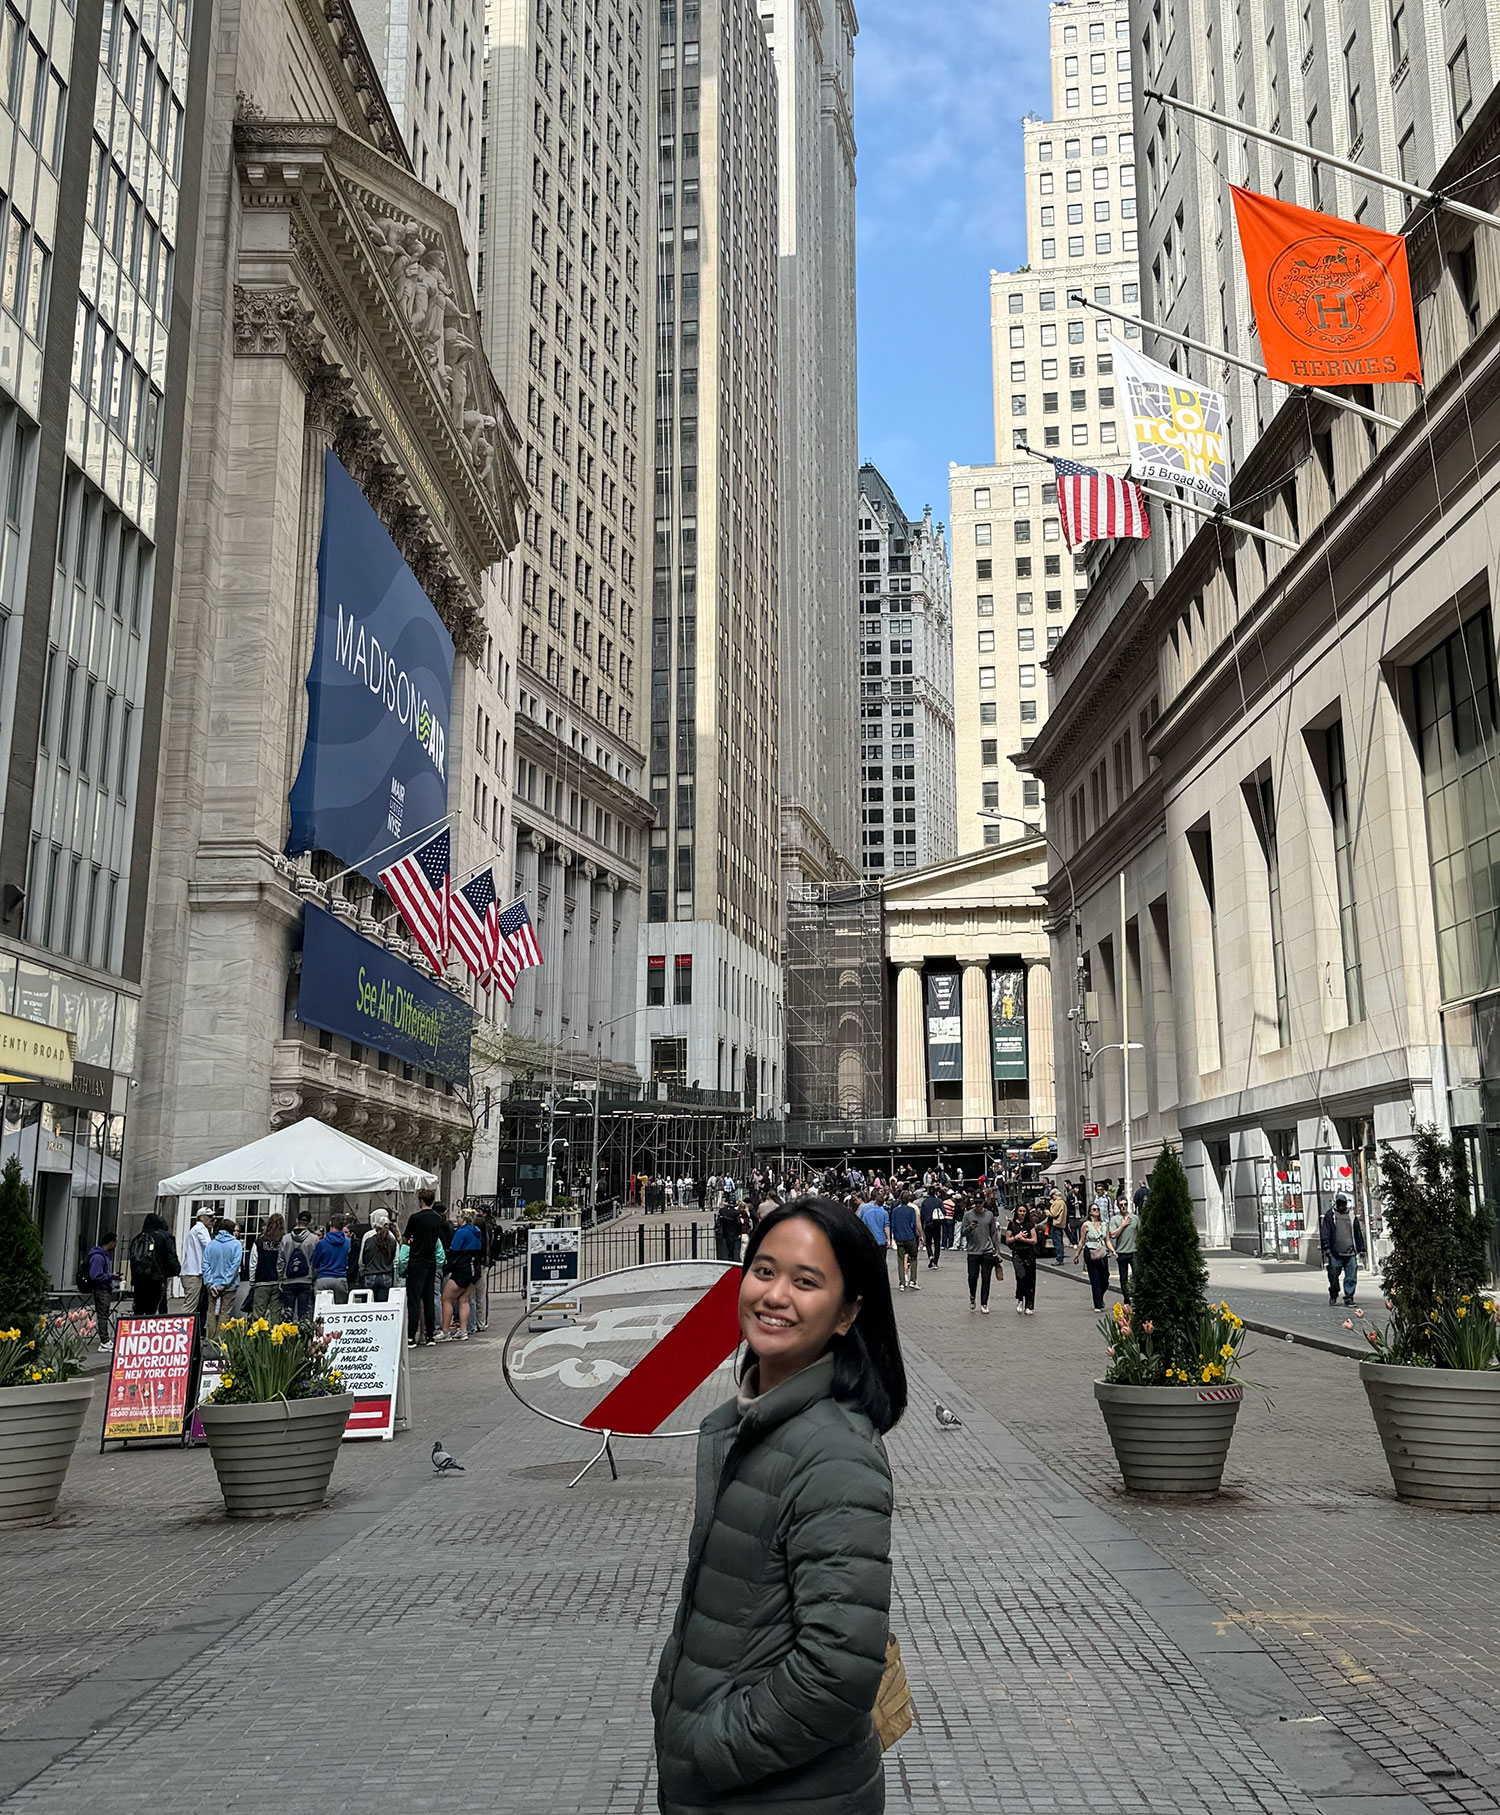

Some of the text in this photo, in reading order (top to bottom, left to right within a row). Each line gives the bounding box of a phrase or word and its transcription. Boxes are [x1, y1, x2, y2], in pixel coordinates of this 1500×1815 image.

[1312, 293, 1352, 329] H
[1291, 356, 1397, 377] HERMES
[1141, 465, 1155, 476] 15
[1158, 467, 1195, 486] Broad
[335, 603, 446, 784] MADISON AIR
[387, 813, 402, 839] NYSE
[356, 966, 441, 1057] See Air Differently
[0, 1034, 65, 1061] ENTY BROAD
[1322, 1165, 1338, 1179] NY
[1323, 1179, 1354, 1192] GIFTS
[130, 1318, 190, 1335] LARGEST
[324, 1313, 395, 1324] OS TACOS No.1
[345, 1328, 368, 1336] TACOS
[119, 1333, 189, 1356] INDOOR
[330, 1345, 380, 1354] QUESADILLAS
[116, 1354, 189, 1369] PLAYGROUND
[334, 1362, 373, 1370] VAMPIROS
[125, 1367, 189, 1380] NEW YORK CITY
[348, 1381, 384, 1389] FRESCAS
